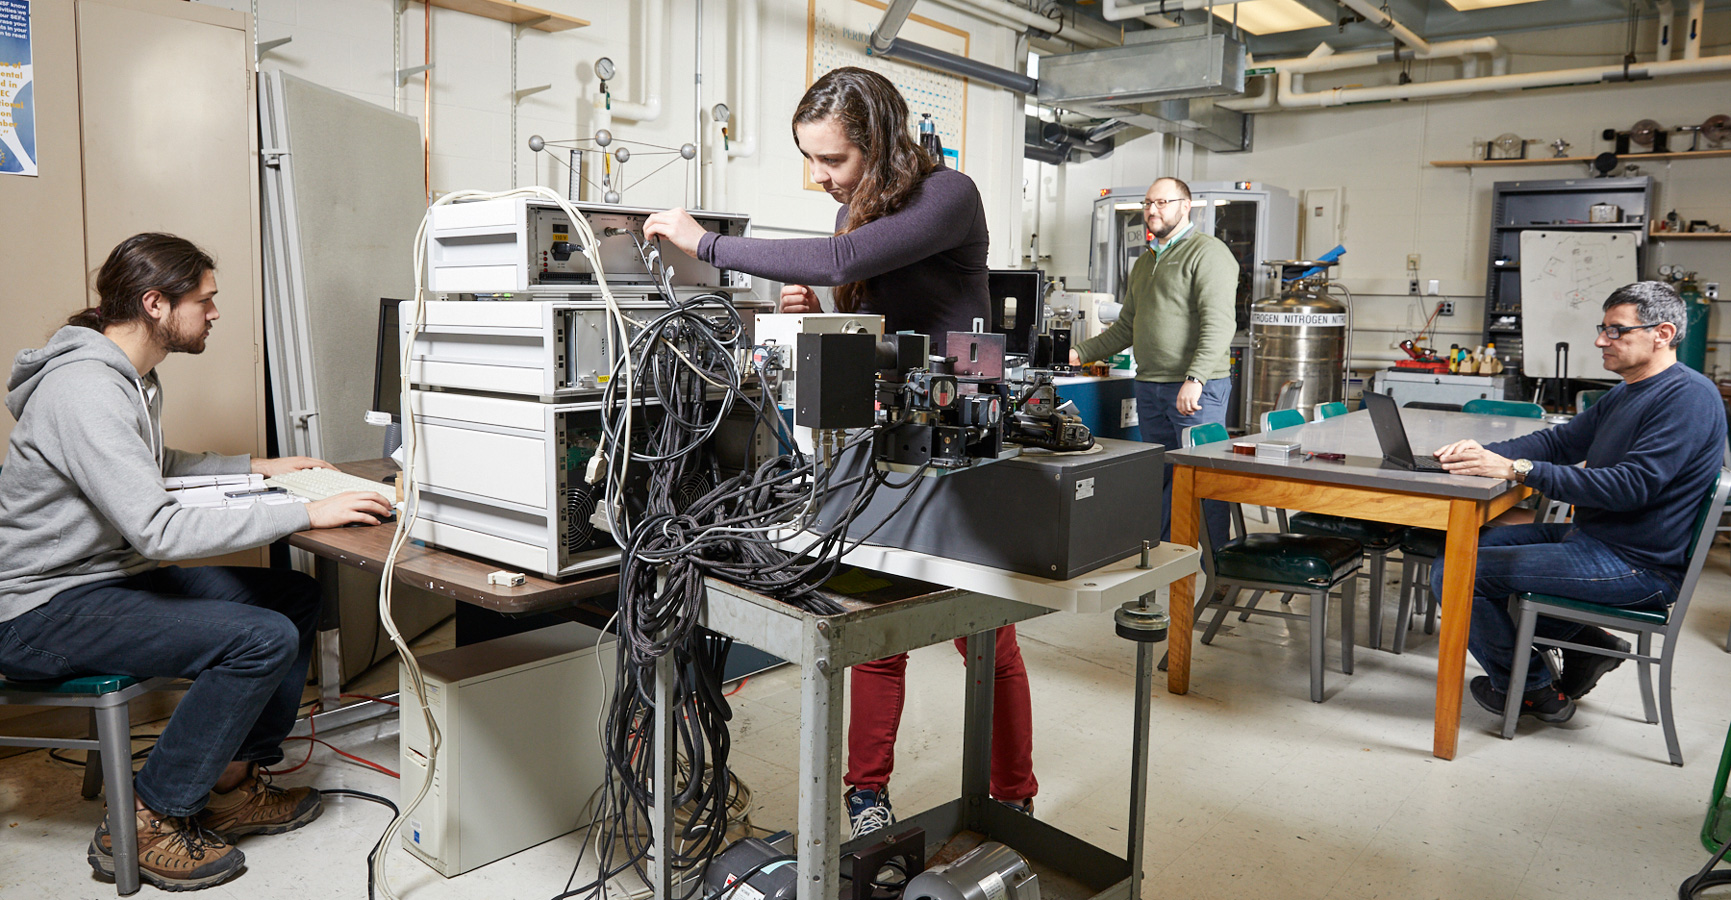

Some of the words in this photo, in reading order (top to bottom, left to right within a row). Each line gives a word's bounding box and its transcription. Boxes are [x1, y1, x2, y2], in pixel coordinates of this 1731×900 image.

[12, 61, 21, 69] of
[8, 80, 17, 88] in
[1127, 230, 1143, 242] D8
[1284, 314, 1328, 324] NITROGEN
